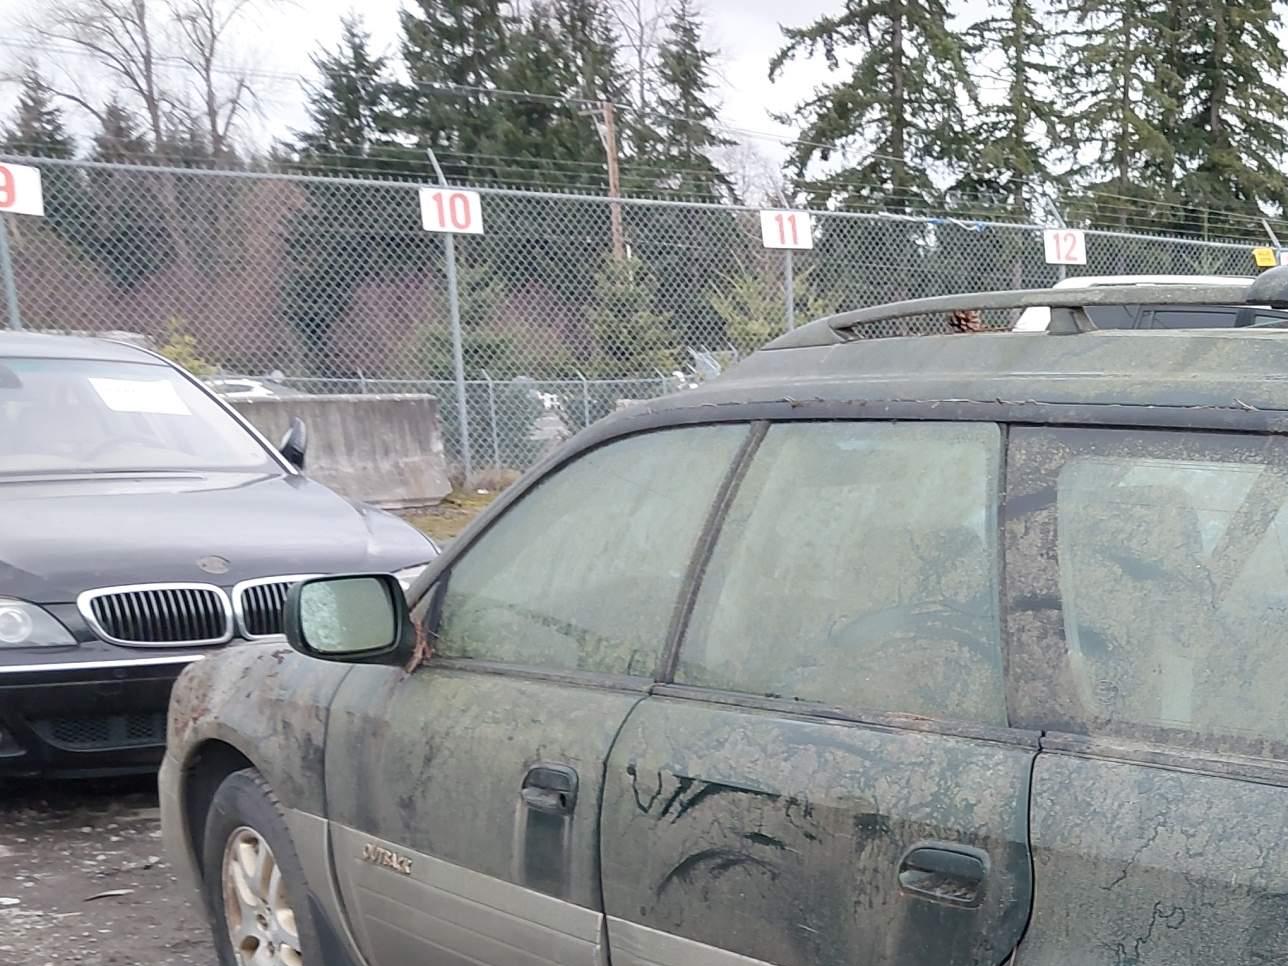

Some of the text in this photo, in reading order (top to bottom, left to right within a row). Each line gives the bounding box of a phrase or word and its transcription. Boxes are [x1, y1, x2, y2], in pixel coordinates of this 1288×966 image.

[432, 192, 471, 229] 10
[774, 213, 798, 245] 11
[1053, 232, 1078, 261] 12
